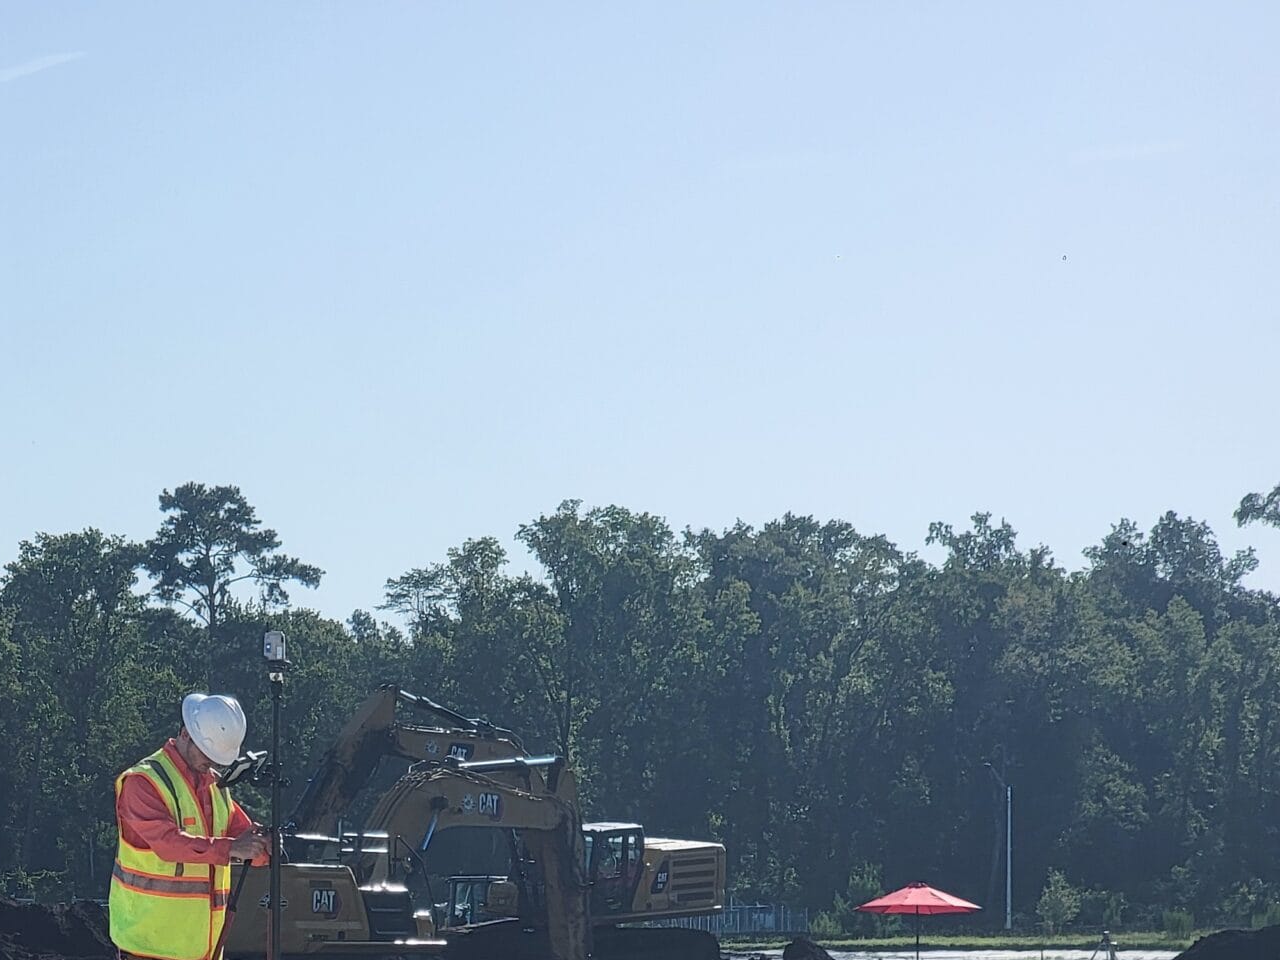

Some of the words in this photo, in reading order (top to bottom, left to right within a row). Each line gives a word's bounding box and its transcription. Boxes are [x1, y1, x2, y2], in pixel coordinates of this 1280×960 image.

[451, 745, 467, 760] CAT
[479, 793, 499, 815] CAT
[657, 872, 668, 882] CAT
[313, 890, 336, 912] CAT
